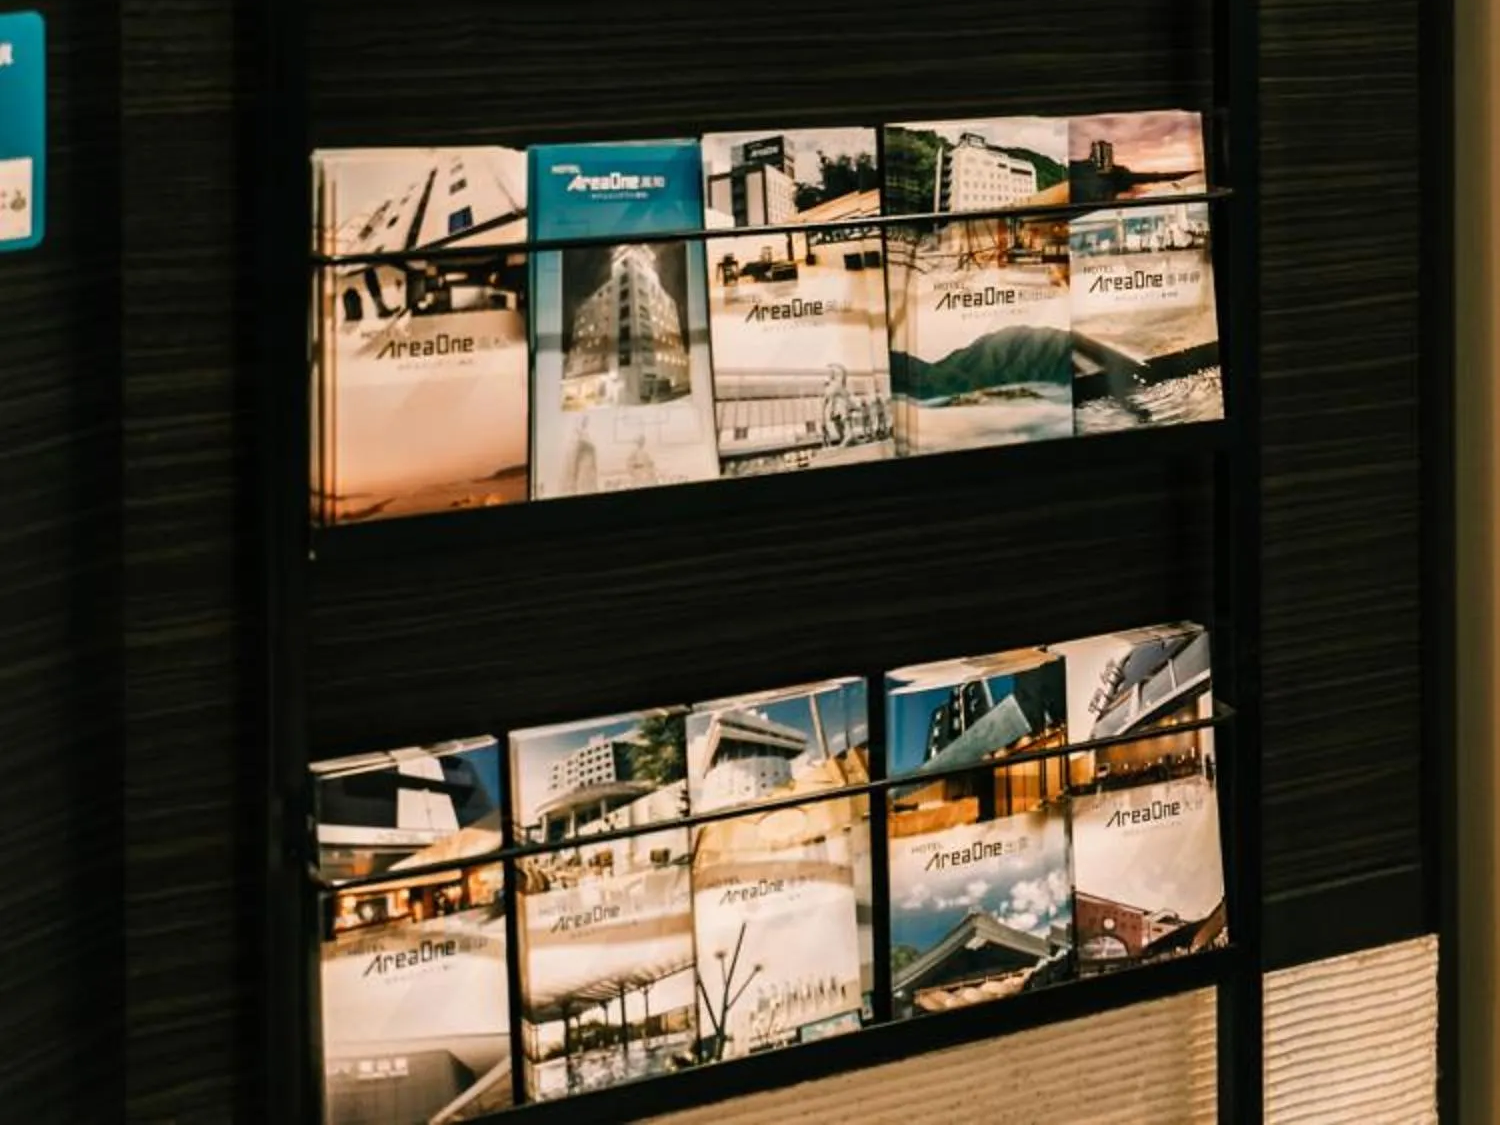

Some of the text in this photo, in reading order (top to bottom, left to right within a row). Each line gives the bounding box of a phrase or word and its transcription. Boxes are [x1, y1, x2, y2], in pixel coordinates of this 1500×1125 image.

[1089, 270, 1163, 293] AreaOne
[745, 298, 824, 323] AreaOne
[935, 286, 1015, 311] AreaOne
[376, 334, 474, 360] AreaOne
[1106, 799, 1181, 828] AreaOne
[924, 840, 1003, 872] AreaOne
[709, 877, 784, 906] AreaOne
[550, 904, 621, 934] AreaOne
[362, 939, 457, 977] AreaOne
